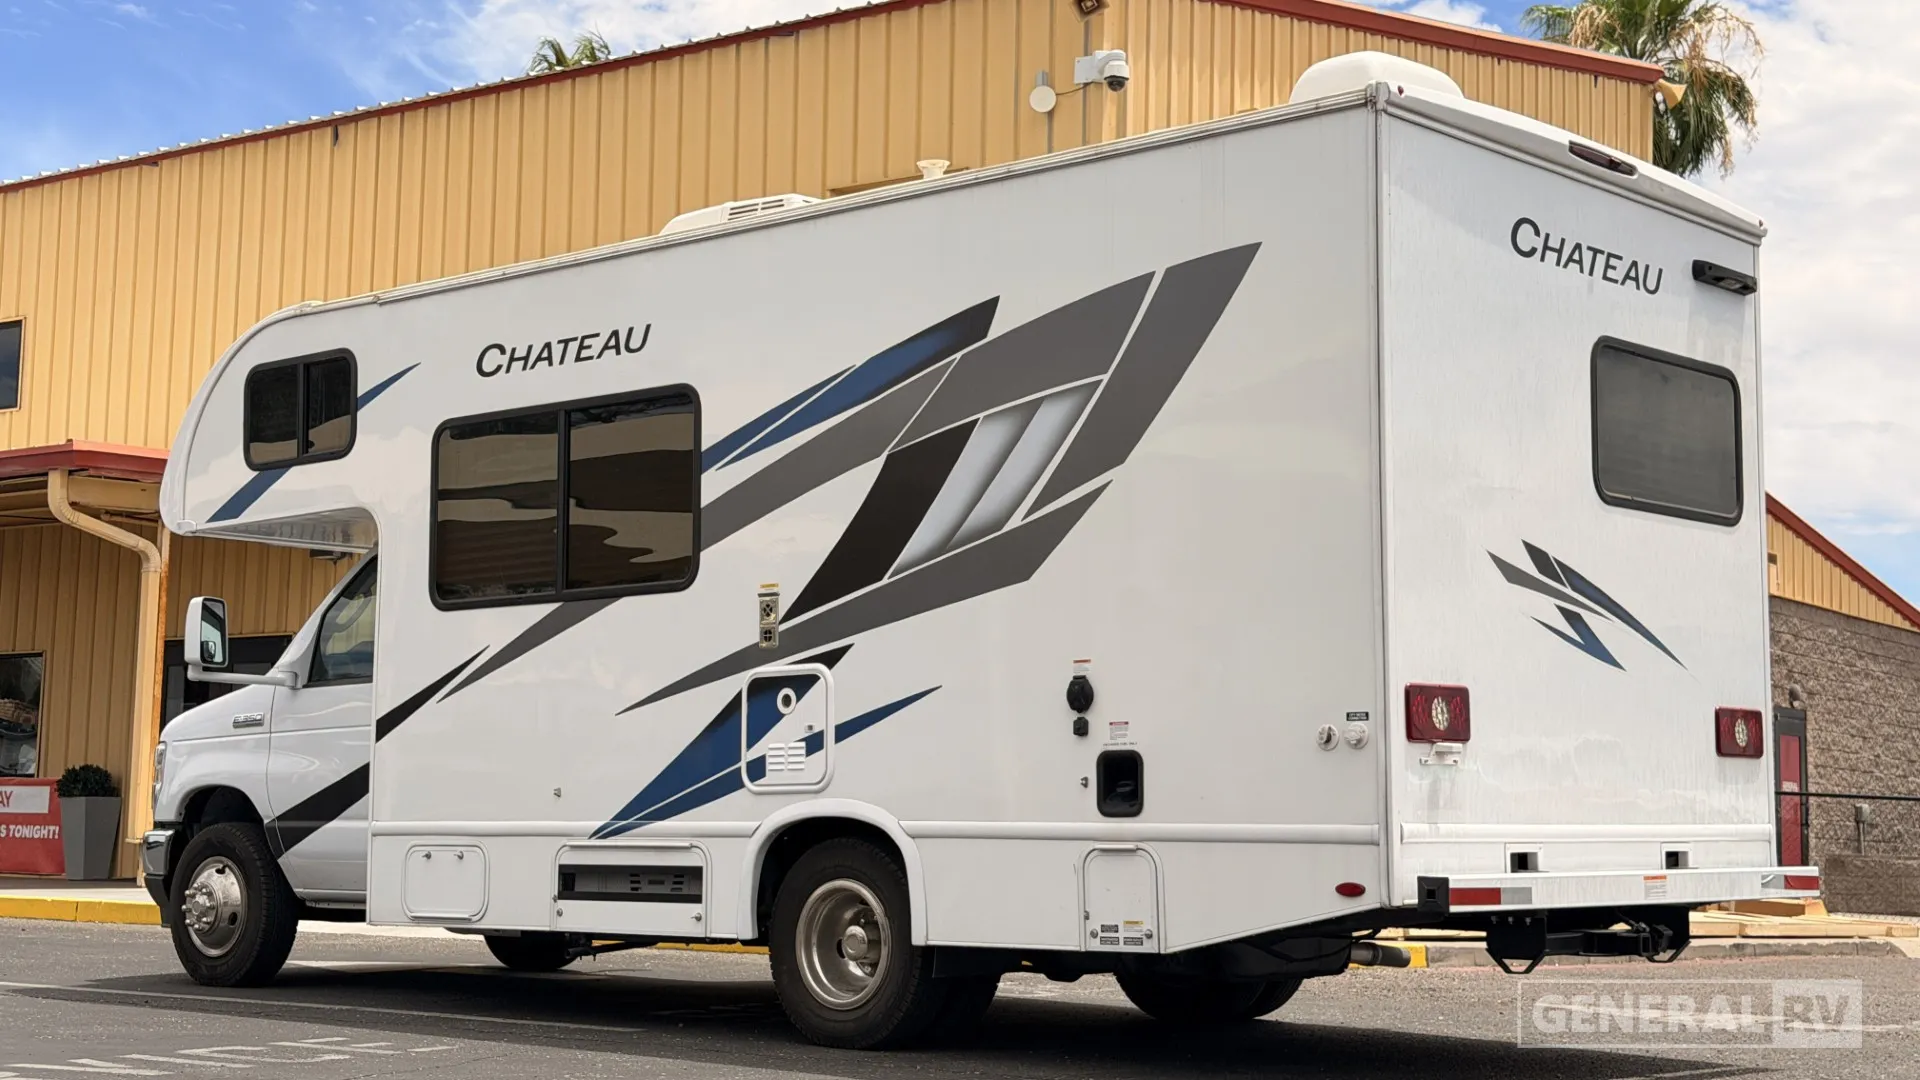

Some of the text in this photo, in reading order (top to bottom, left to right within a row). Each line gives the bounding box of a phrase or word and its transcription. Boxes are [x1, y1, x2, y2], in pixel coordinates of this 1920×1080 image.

[1510, 216, 1664, 295] CHATEAU
[475, 323, 652, 378] CHATEAU
[8, 824, 60, 839] TONIGHT!
